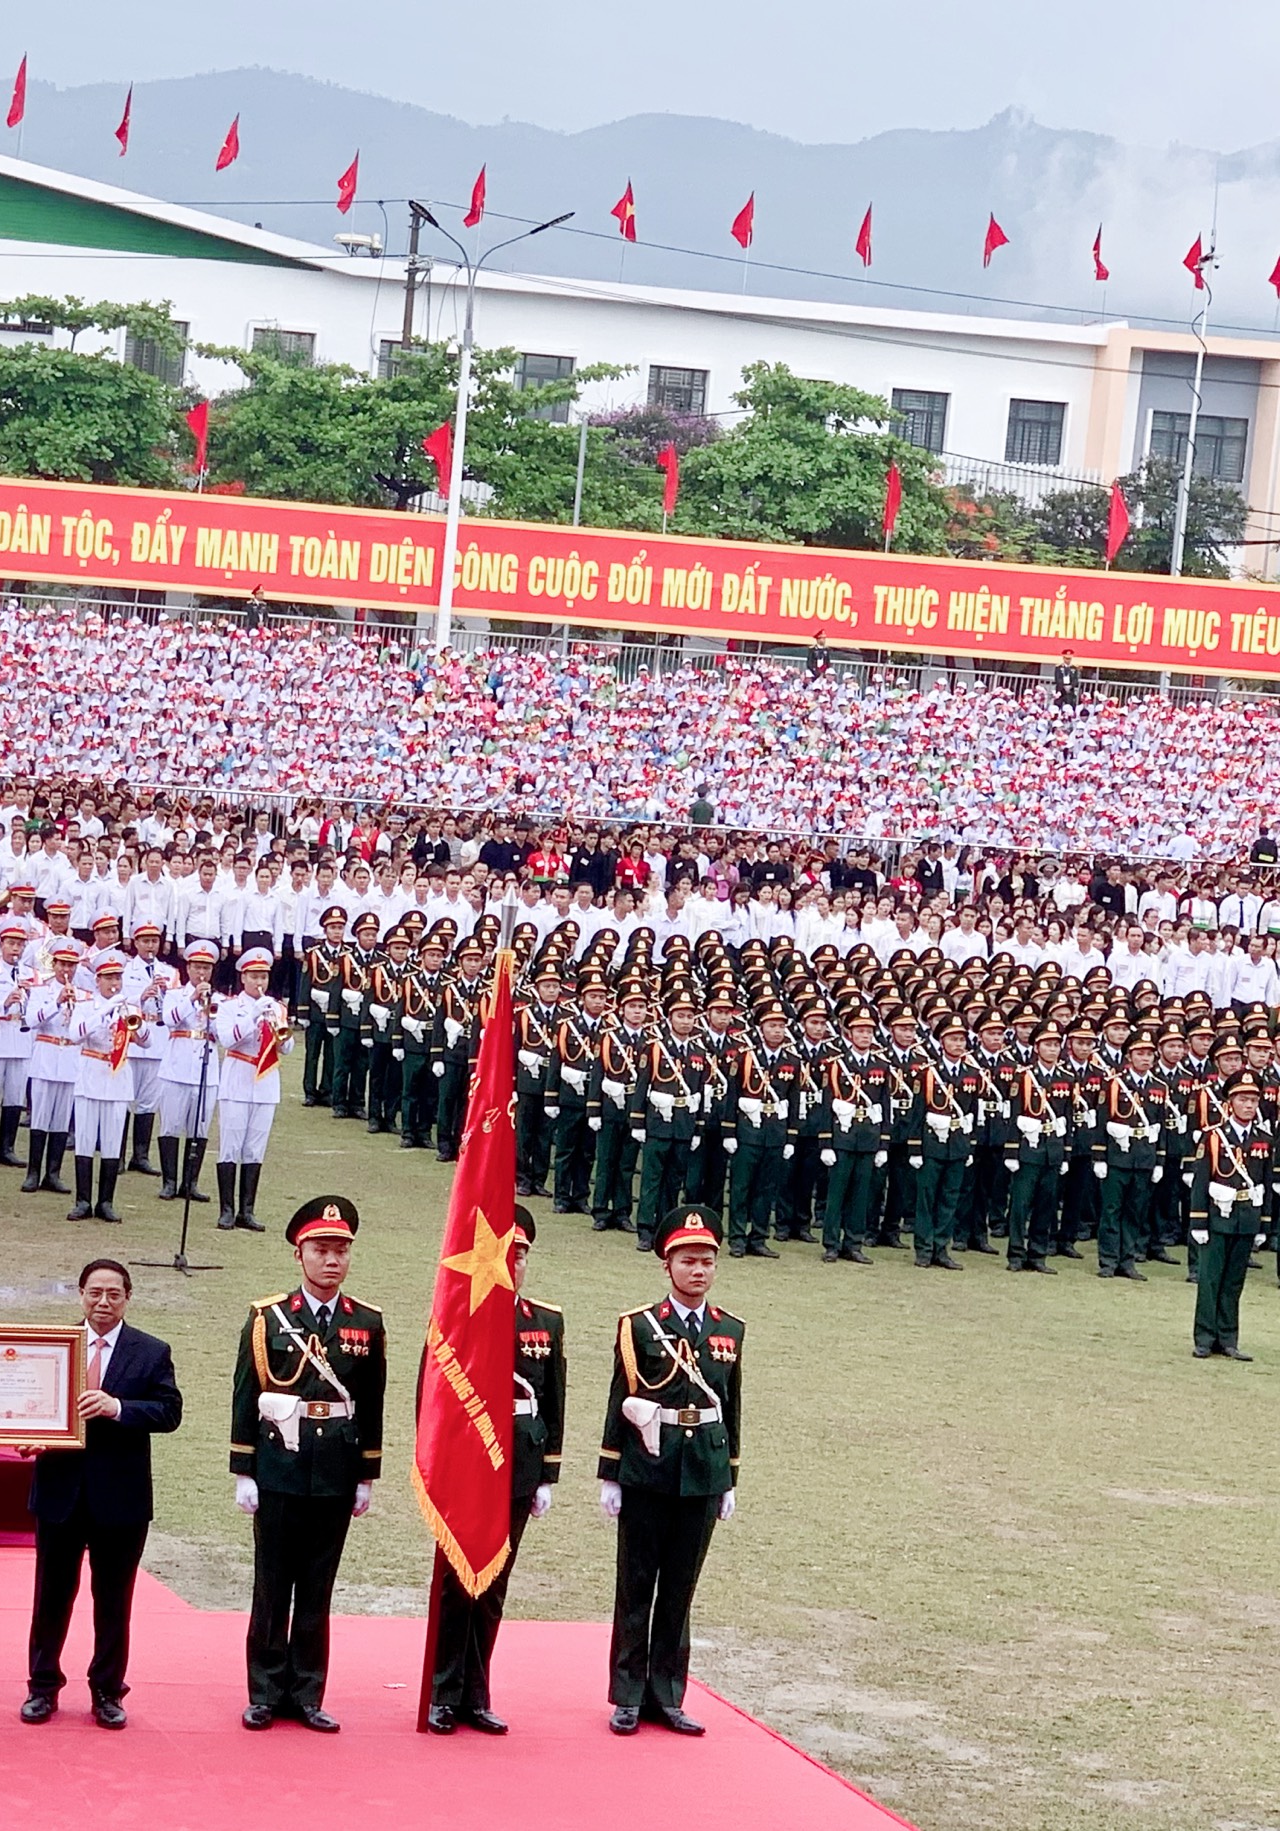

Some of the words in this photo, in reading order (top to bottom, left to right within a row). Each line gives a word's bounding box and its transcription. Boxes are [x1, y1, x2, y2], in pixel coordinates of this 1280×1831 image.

[61, 509, 120, 567] TỘC,
[130, 508, 187, 565] ĐẨY
[195, 527, 279, 579] MẠNH
[289, 530, 361, 581] TOÀN
[370, 537, 435, 594] DIỆN
[453, 541, 519, 594] CÔNG
[527, 550, 599, 608] CUỘC
[607, 549, 653, 605] ĐỔI
[661, 562, 713, 611] MỚI
[721, 561, 773, 615] ĐẤT
[780, 573, 859, 628] NƯỚC,
[873, 584, 939, 636] THỰC
[947, 585, 1010, 641] HIỆN
[1019, 585, 1105, 642] THẮNG
[1112, 602, 1154, 653] LỢI
[1161, 607, 1221, 657] MỤC
[1230, 607, 1280, 655] TIÊU
[442, 1358, 475, 1401] TRANG
